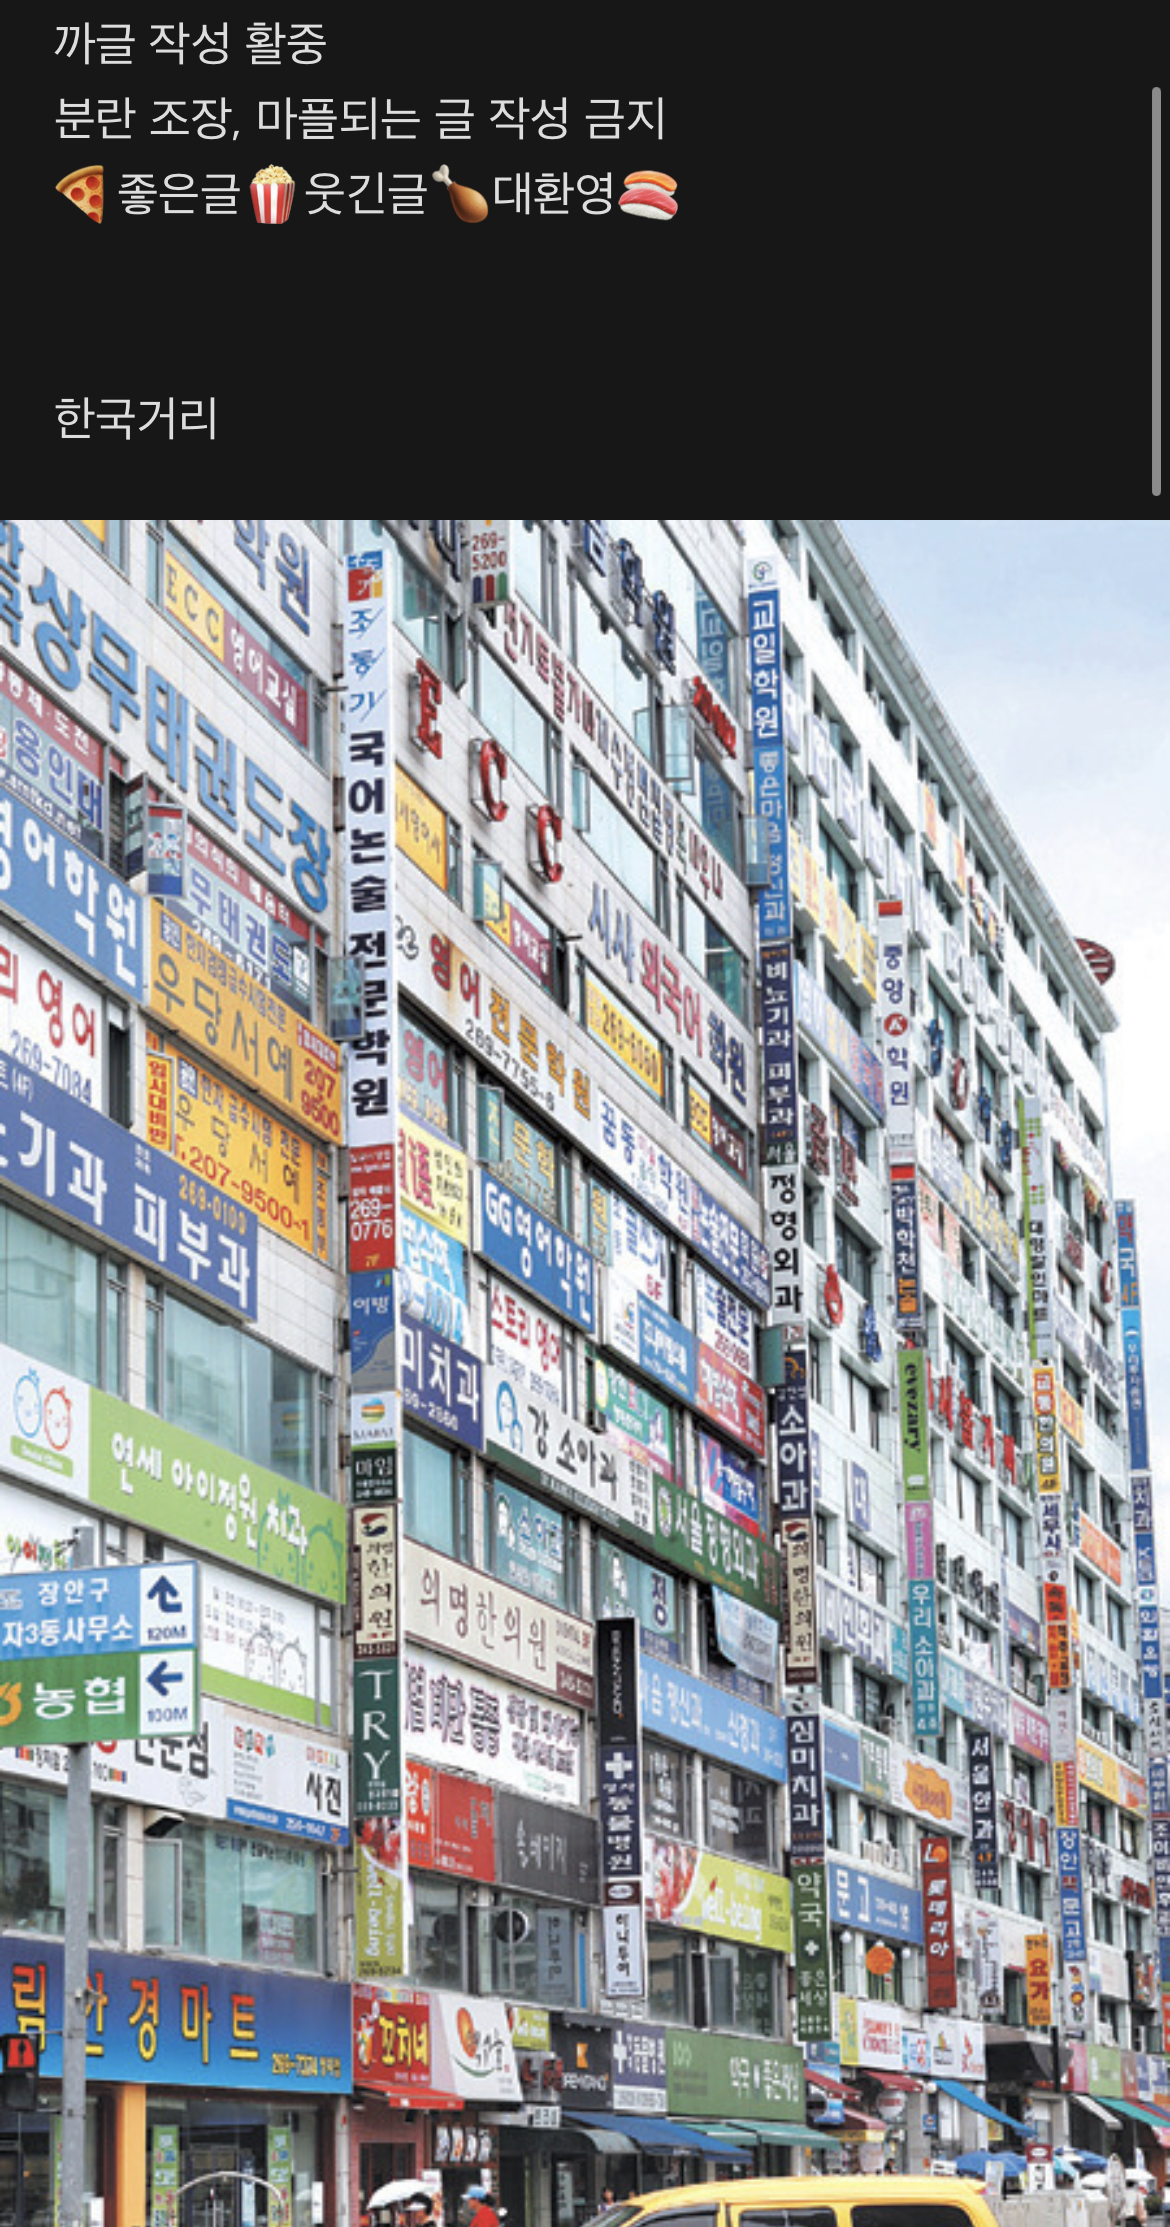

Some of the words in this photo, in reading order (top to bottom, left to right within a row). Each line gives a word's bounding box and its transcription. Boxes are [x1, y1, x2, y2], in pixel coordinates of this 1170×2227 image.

[472, 552, 506, 571] 5200
[165, 566, 220, 645] ECC
[229, 626, 297, 727] 영어교실
[753, 600, 779, 739] 교일학원
[15, 718, 102, 830] 용인대
[882, 946, 904, 1004] 중앙
[38, 970, 95, 1058] 영어
[154, 952, 294, 1103] 우당서예
[642, 938, 702, 1058] 외국어
[708, 1010, 747, 1106] 학원
[10, 1029, 92, 1108] 269-7084
[303, 1057, 336, 1098] 207
[768, 1063, 793, 1126] 피부과
[887, 1047, 908, 1106] 학원
[0, 1110, 107, 1227] 기과
[133, 1181, 251, 1310] 피부과
[351, 1219, 393, 1242] 0776
[771, 1174, 803, 1313] 정형외과
[491, 1285, 531, 1348] 스토리
[904, 1363, 921, 1453] evezary
[355, 1456, 394, 1478] 마임
[527, 1406, 549, 1459] 강
[556, 1430, 617, 1501] 소아과
[779, 1405, 811, 1512] 소아과
[112, 1432, 163, 1494] 연세
[172, 1459, 258, 1550] 아이정원
[267, 1497, 309, 1556] 치과
[1042, 1503, 1062, 1550] 세무사
[38, 1577, 110, 1607] 장안구
[368, 1557, 394, 1630] 한의원
[420, 1566, 547, 1672] 의명한의원
[911, 1584, 933, 1629] 우리
[3, 1615, 134, 1648] 자3동사무소
[148, 1625, 188, 1641] 120M
[33, 1676, 126, 1720] 농협
[357, 1668, 393, 1780] TRY
[305, 1771, 342, 1816] 사진
[789, 1720, 821, 1827] 심미치과
[971, 1736, 994, 1839] 서울안과
[796, 1871, 824, 1928] 약국
[836, 1868, 872, 1924] 문고
[927, 1879, 950, 1957] 롯데리아
[1029, 1957, 1050, 2001] 요가
[378, 2014, 429, 2069] 꼬치네
